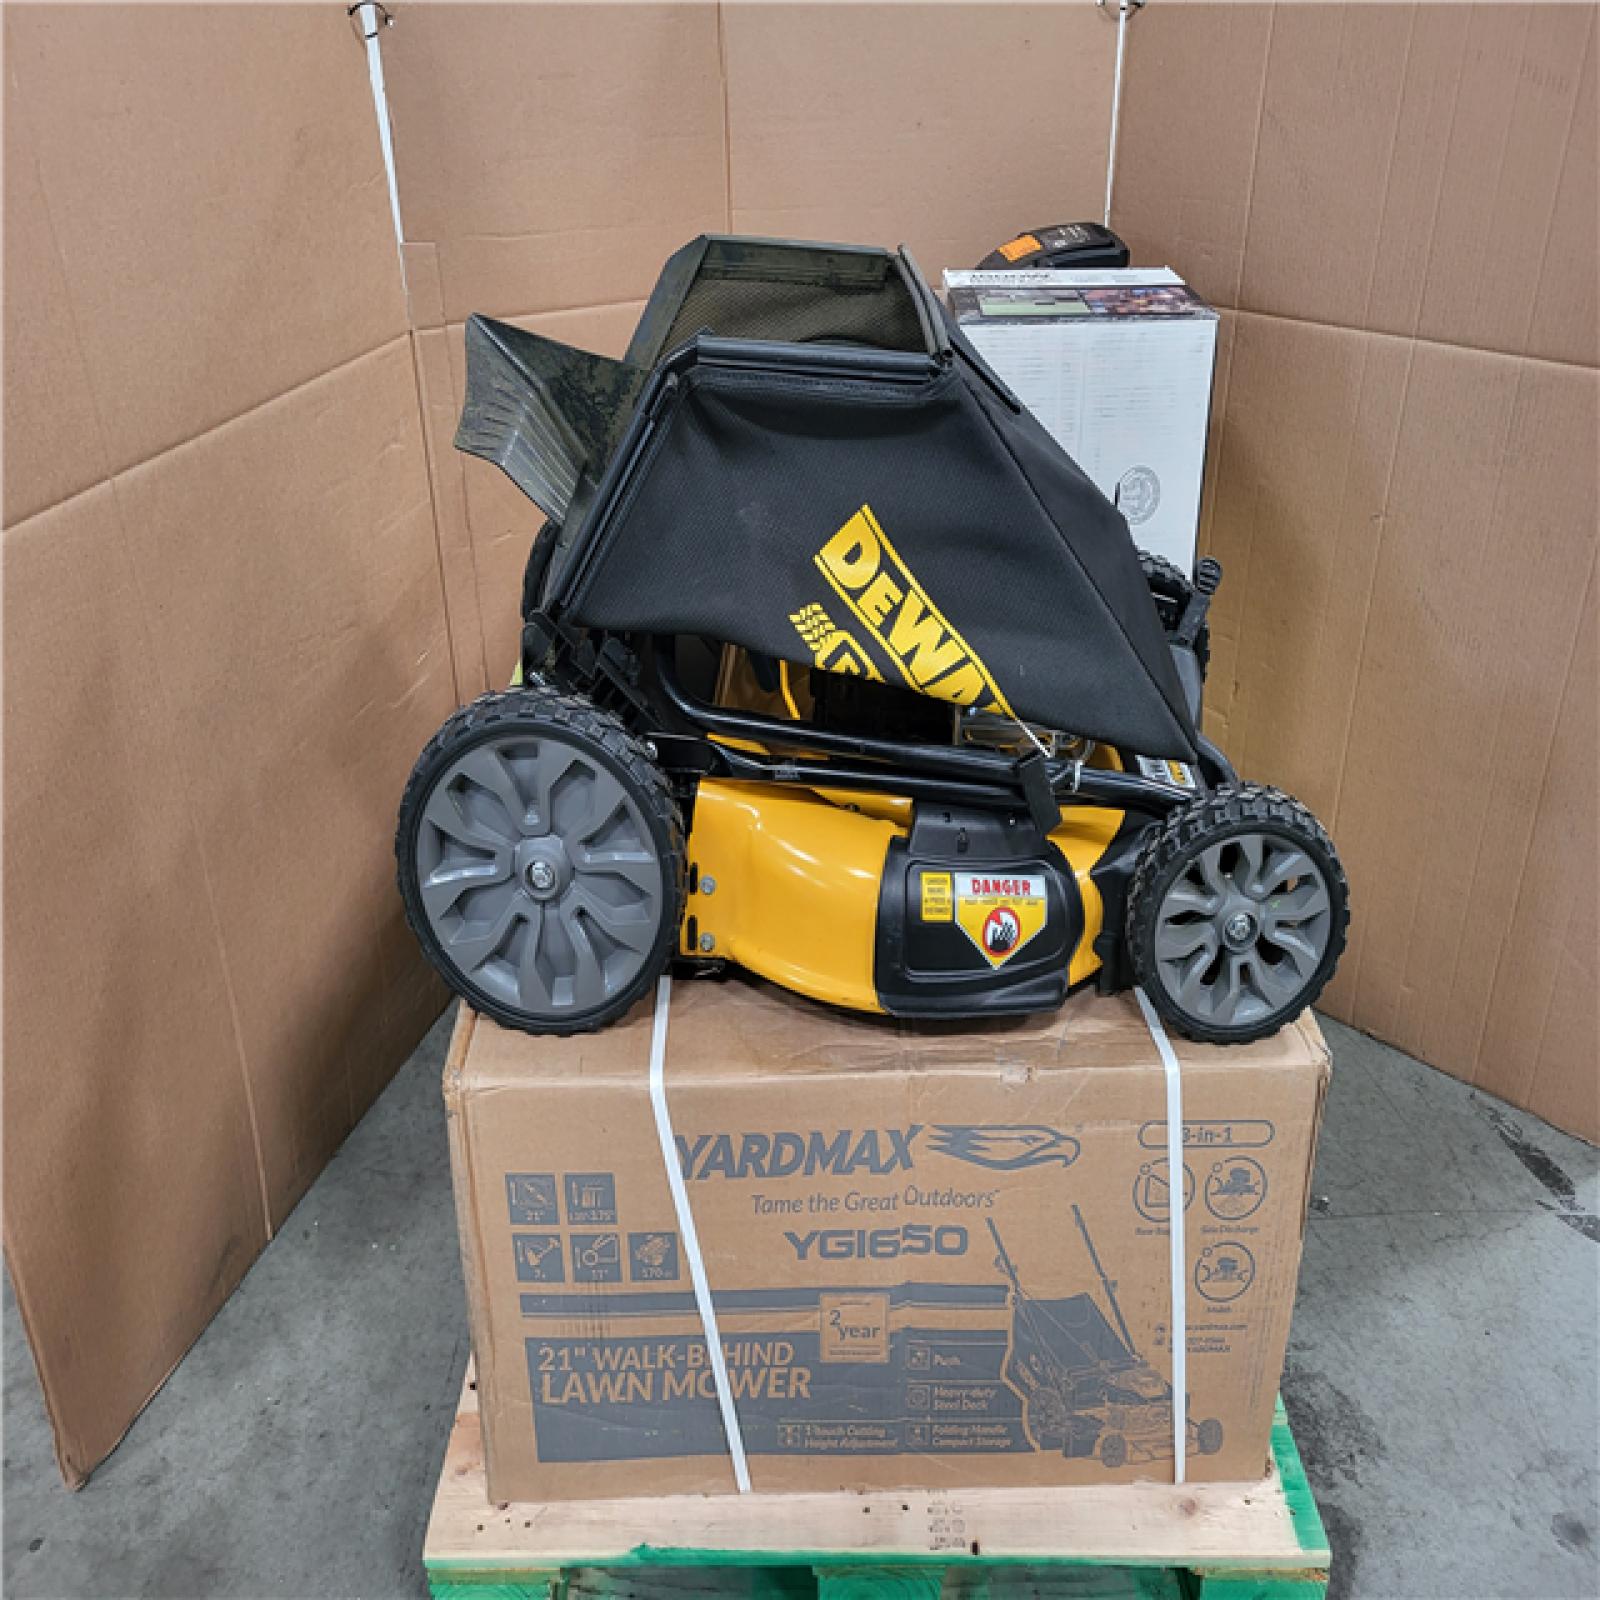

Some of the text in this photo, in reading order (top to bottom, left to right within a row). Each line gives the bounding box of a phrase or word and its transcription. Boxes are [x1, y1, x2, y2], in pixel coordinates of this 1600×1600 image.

[815, 504, 1008, 716] DEWA
[971, 878, 1031, 896] DANGER
[674, 1124, 924, 1181] YARDMAX
[752, 1184, 994, 1216] Tame the Great Outdoors
[829, 1309, 841, 1326] 2
[839, 1326, 881, 1342] year
[538, 1341, 793, 1372] 21" WALK-BHIND
[542, 1366, 812, 1404] LAWN MOWER
